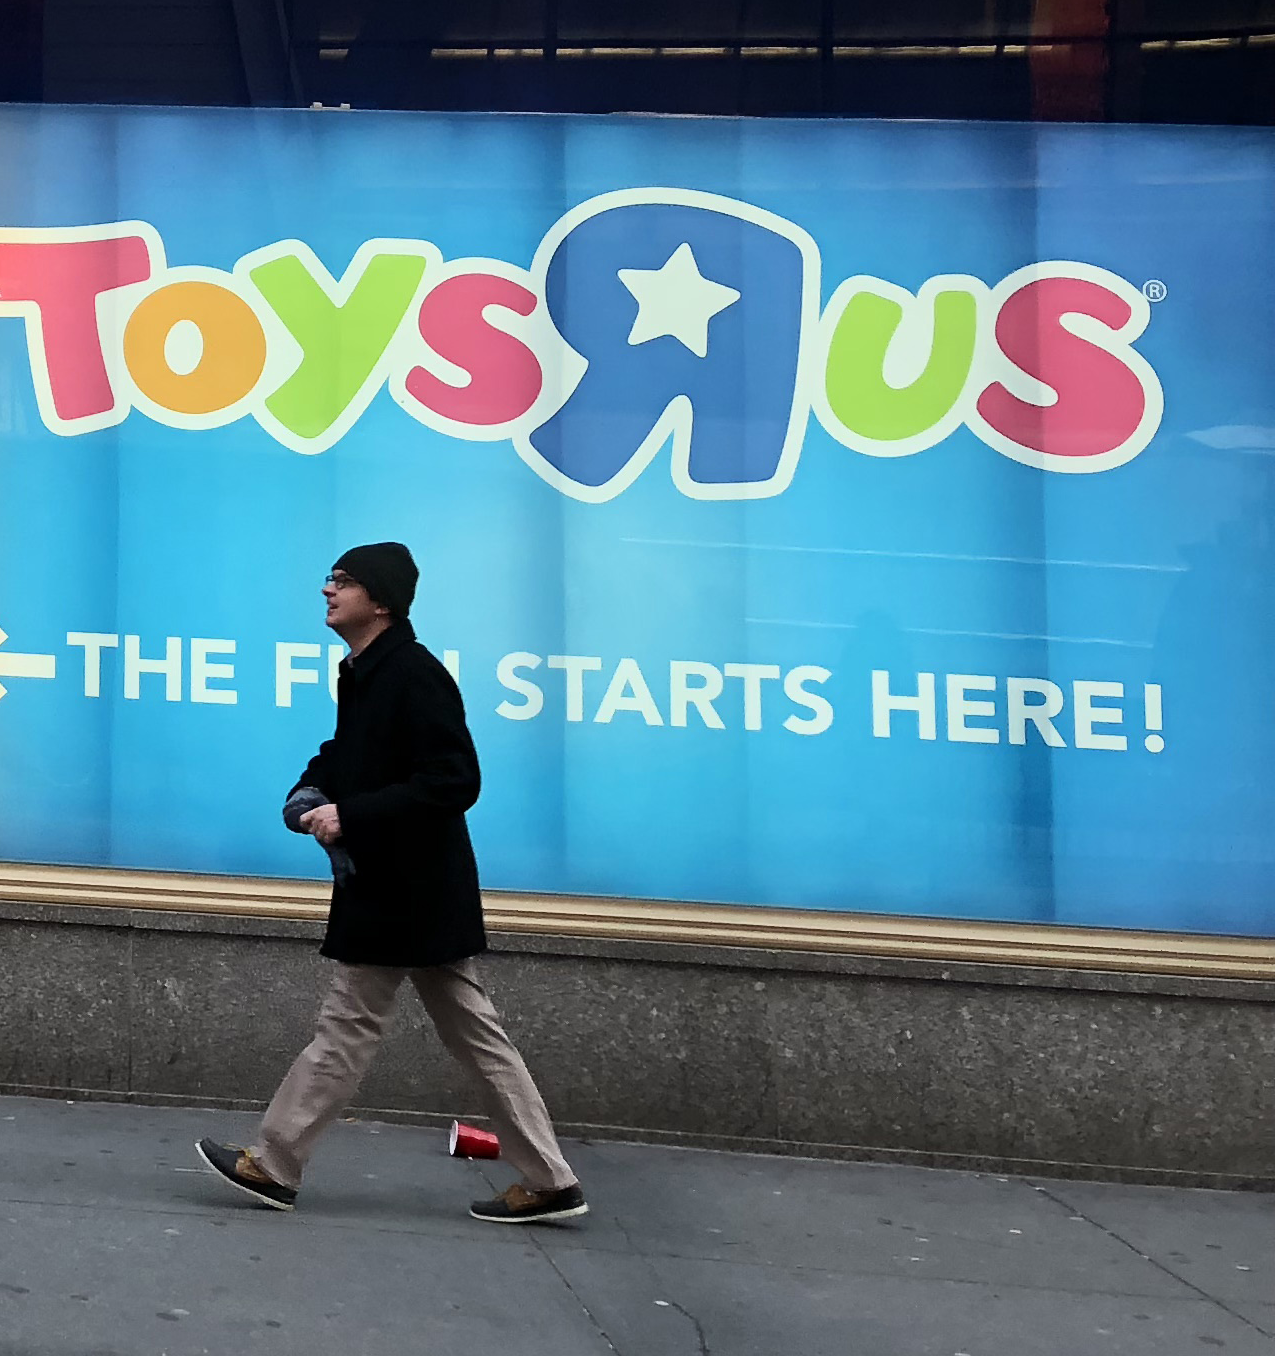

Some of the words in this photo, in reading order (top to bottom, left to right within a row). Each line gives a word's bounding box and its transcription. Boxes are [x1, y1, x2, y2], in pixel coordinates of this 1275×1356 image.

[66, 631, 238, 705] THE
[494, 651, 834, 736] STARTS
[871, 670, 1165, 754] HERE!
